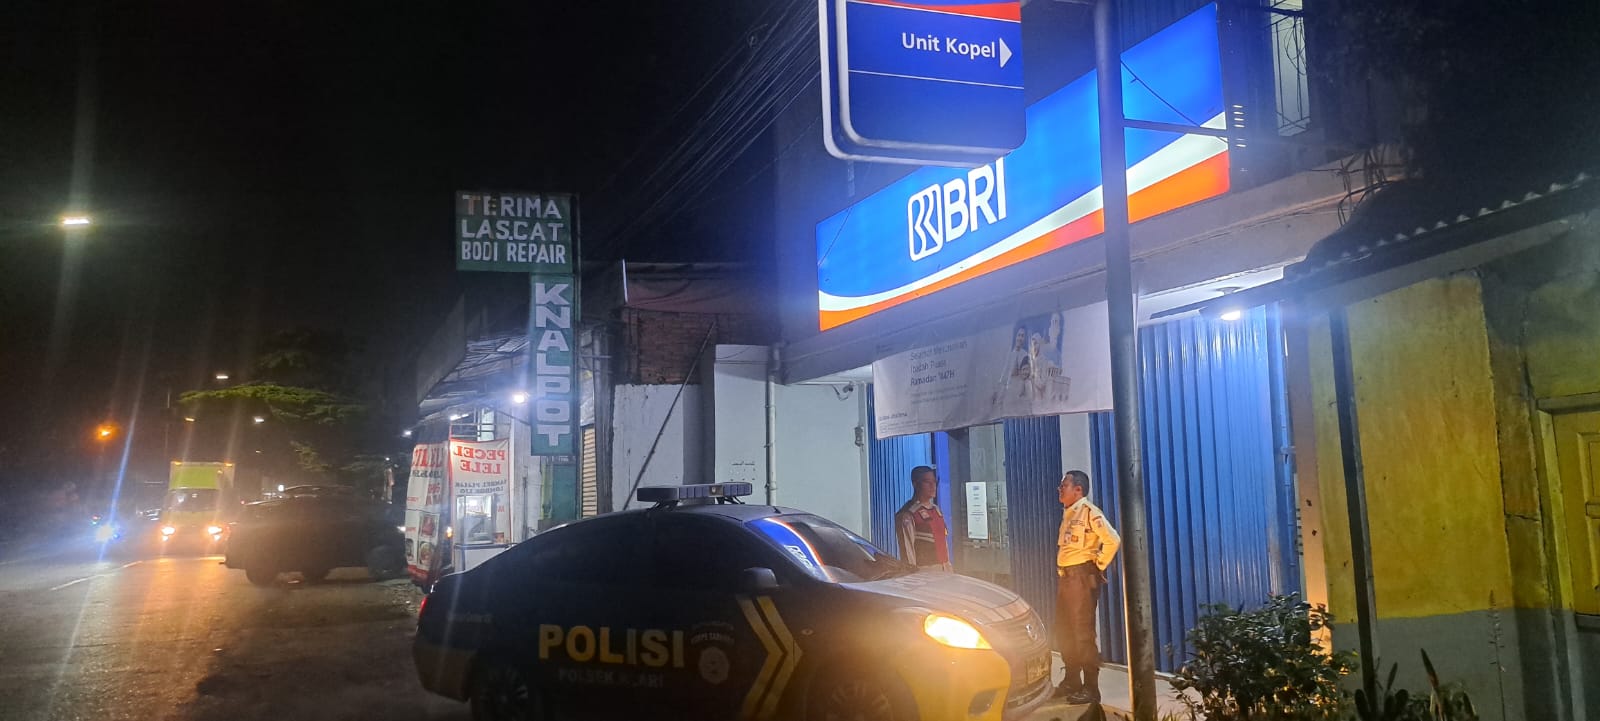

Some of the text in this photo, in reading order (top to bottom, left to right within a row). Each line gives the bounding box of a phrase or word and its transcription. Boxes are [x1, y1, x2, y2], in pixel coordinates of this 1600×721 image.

[902, 32, 995, 60] Unit Kopel
[462, 194, 562, 219] TERIMA
[943, 157, 1007, 243] BRI
[461, 241, 566, 264] BODI REPAIR
[535, 283, 571, 446] KNALPOT
[538, 624, 685, 668] POLISI
